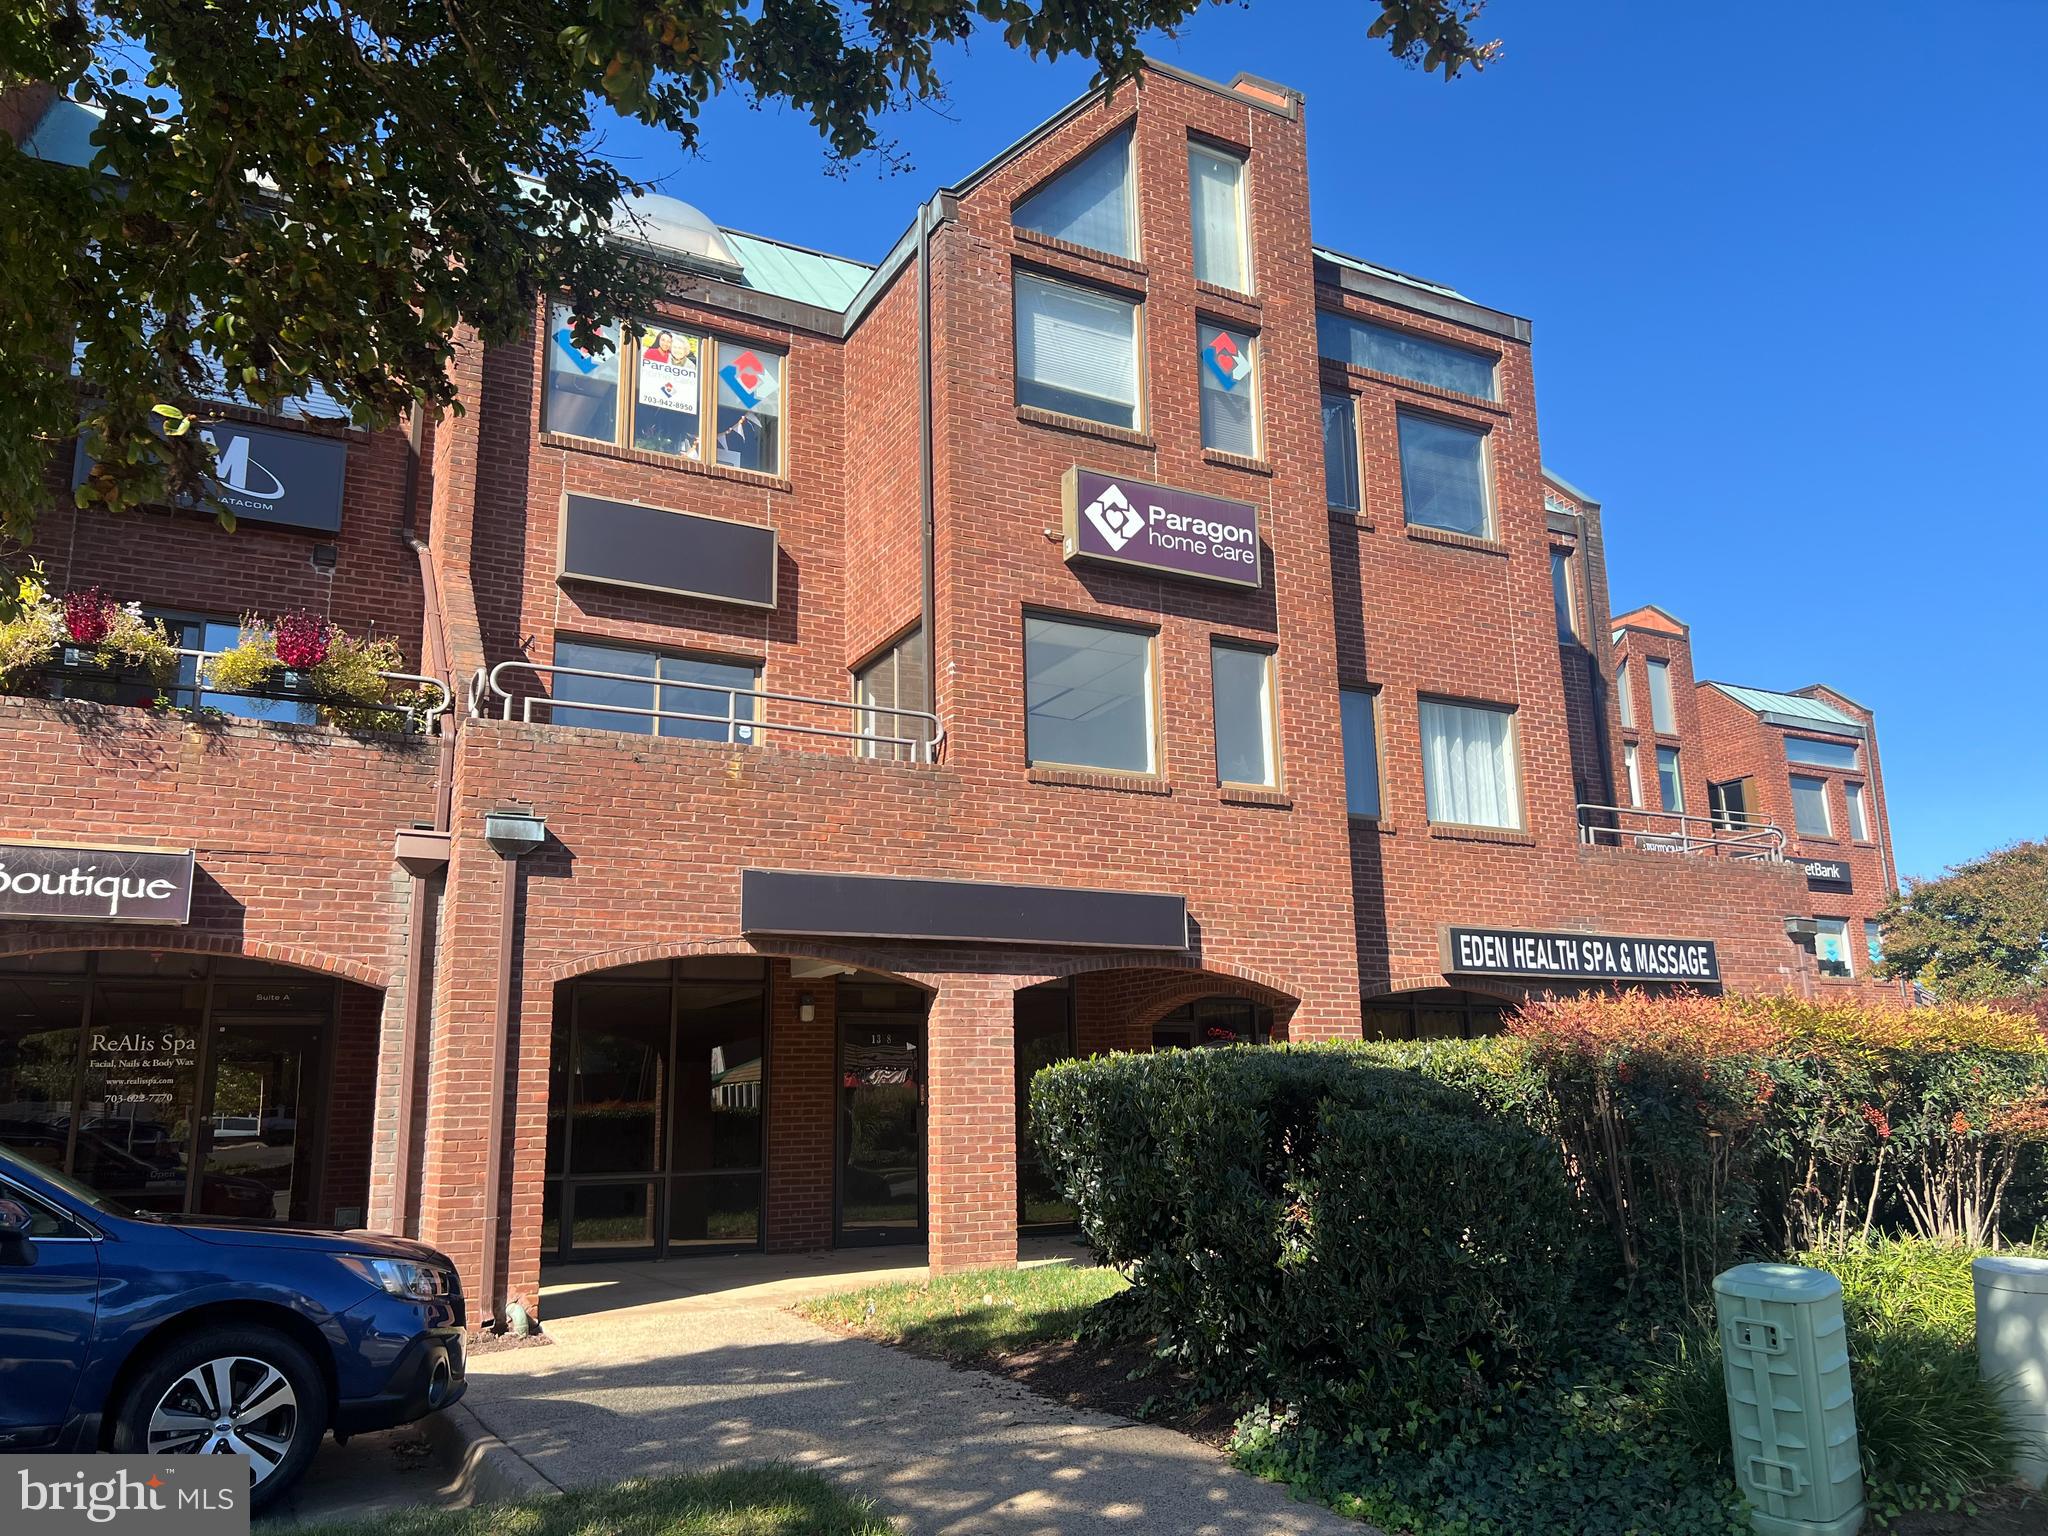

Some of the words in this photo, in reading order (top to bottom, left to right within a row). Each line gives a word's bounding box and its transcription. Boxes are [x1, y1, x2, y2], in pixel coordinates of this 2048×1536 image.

[642, 358, 696, 378] Paragon
[643, 395, 693, 411] 703-942-8950
[217, 497, 274, 511] ATACOM
[1148, 504, 1253, 545] Paragon
[1149, 527, 1207, 555] home
[1211, 543, 1255, 564] care
[1459, 934, 1509, 968] EDEN
[1512, 937, 1580, 971] HEALTH
[1583, 940, 1618, 973] SPA
[1620, 943, 1633, 973] &
[1634, 943, 1711, 976] MASSAGE
[256, 993, 281, 1001] Suite
[283, 993, 291, 1001] A
[1207, 1026, 1238, 1041] OPEN
[91, 1033, 155, 1052] ReAlis
[160, 1033, 196, 1055] Spa
[89, 1059, 116, 1069] Facial,
[119, 1059, 140, 1068] Nails
[142, 1060, 151, 1068] &
[152, 1058, 174, 1069] Body
[175, 1058, 195, 1067] Wax
[106, 1077, 174, 1087] www.realisspa.com
